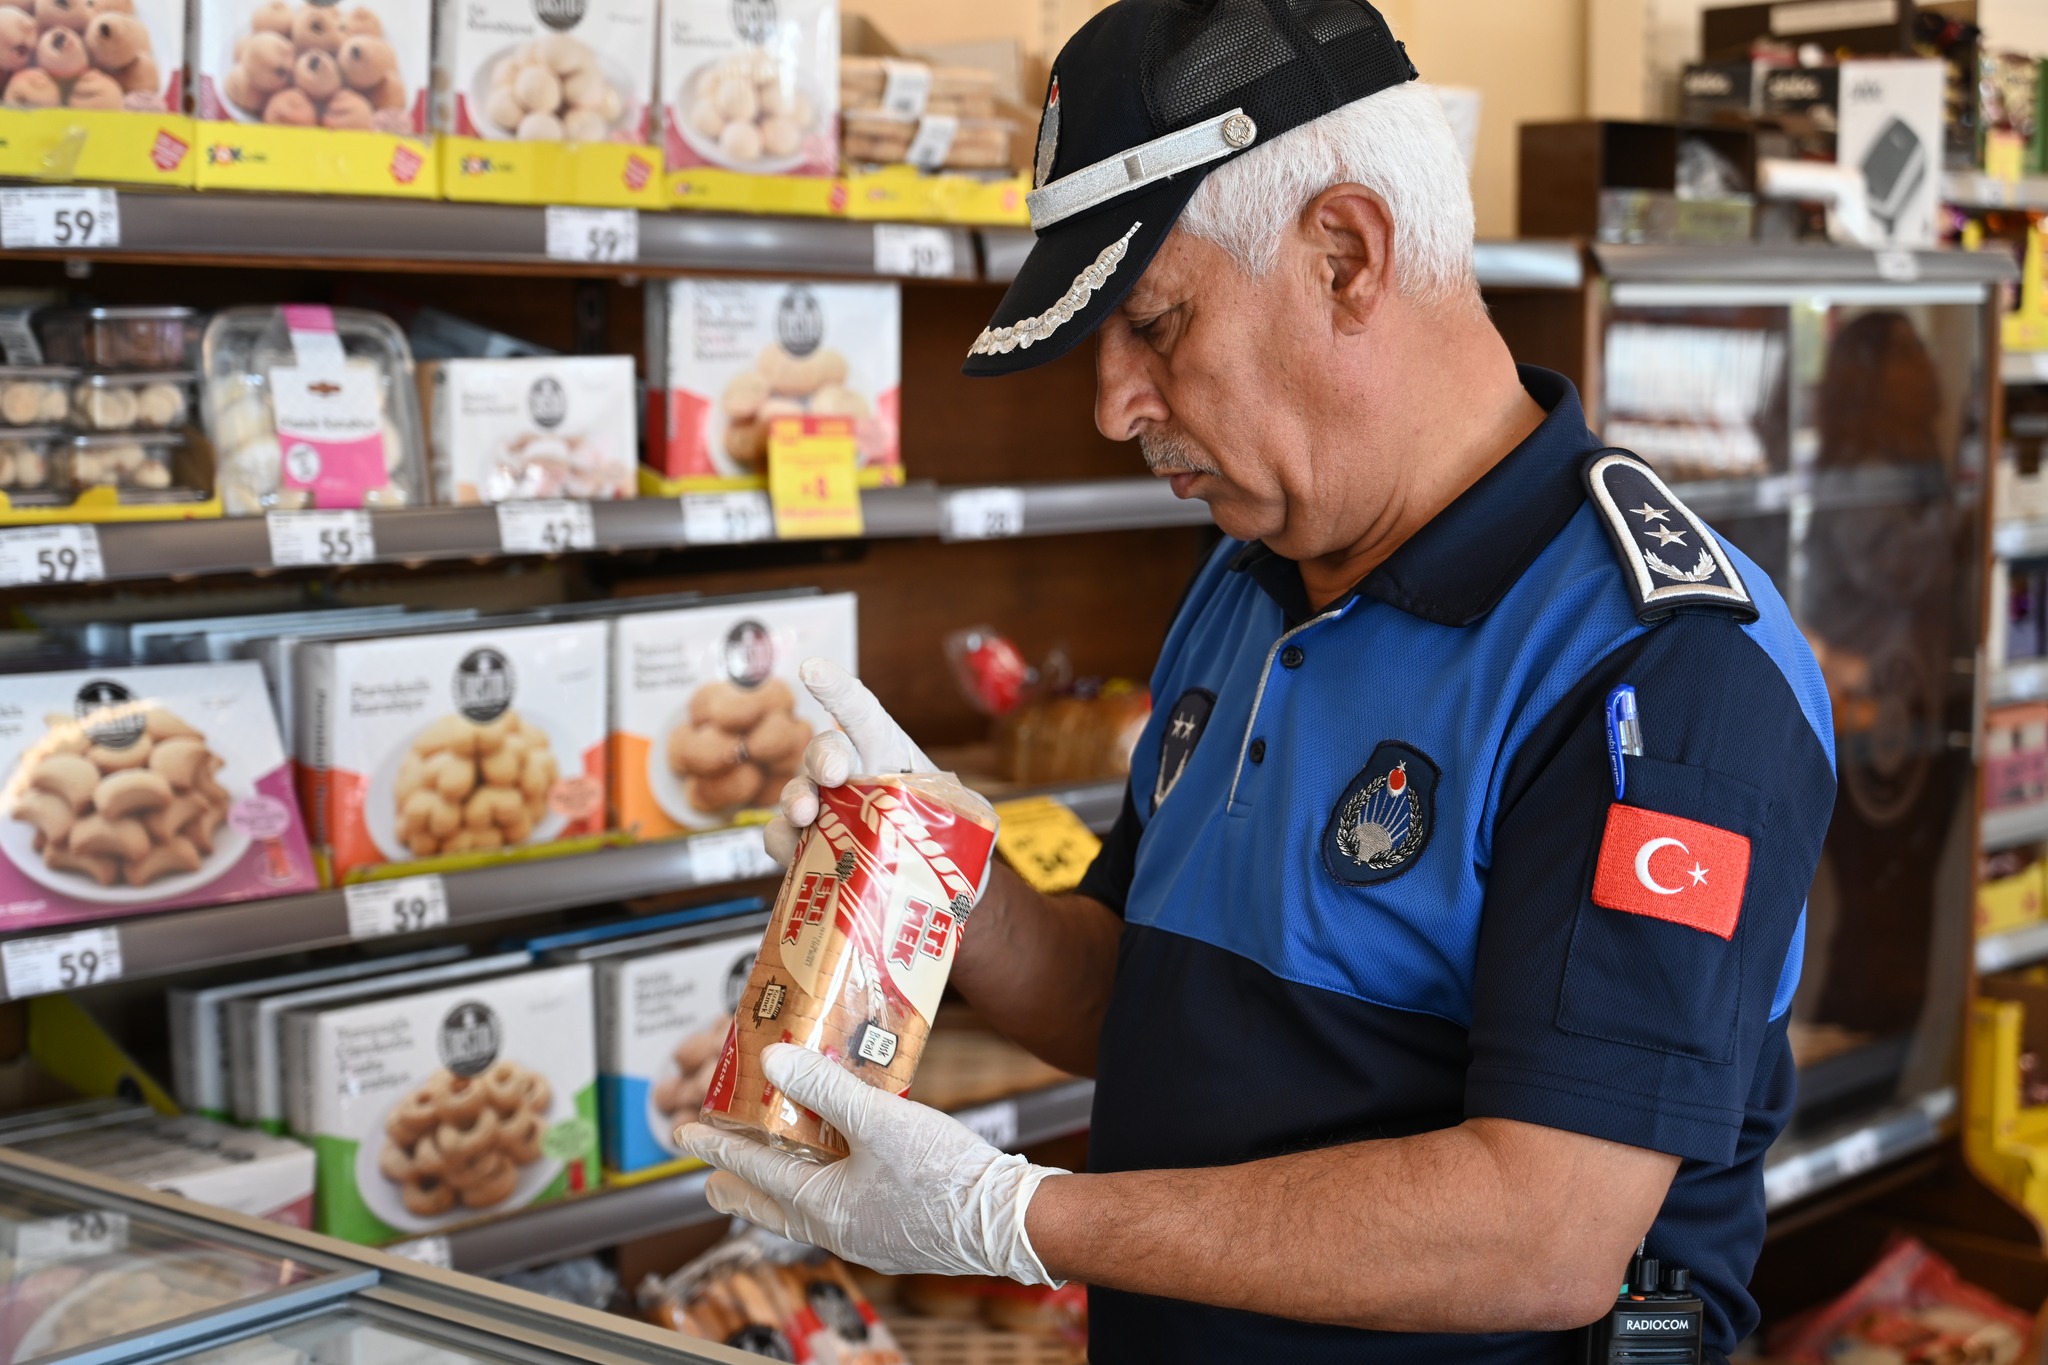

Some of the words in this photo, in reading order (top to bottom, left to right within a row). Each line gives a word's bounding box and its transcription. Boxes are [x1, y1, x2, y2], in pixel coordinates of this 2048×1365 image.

[54, 208, 95, 246] 59
[319, 528, 353, 563] 55
[37, 547, 78, 584] 59
[393, 897, 427, 933] 59
[783, 873, 820, 943] MEK
[890, 898, 930, 967] MEK
[59, 950, 99, 988] 59
[863, 1030, 881, 1057] Bread
[877, 1036, 894, 1058] Rusk
[712, 1045, 735, 1097] Klasik
[1626, 1319, 1689, 1331] RADIOCOM
